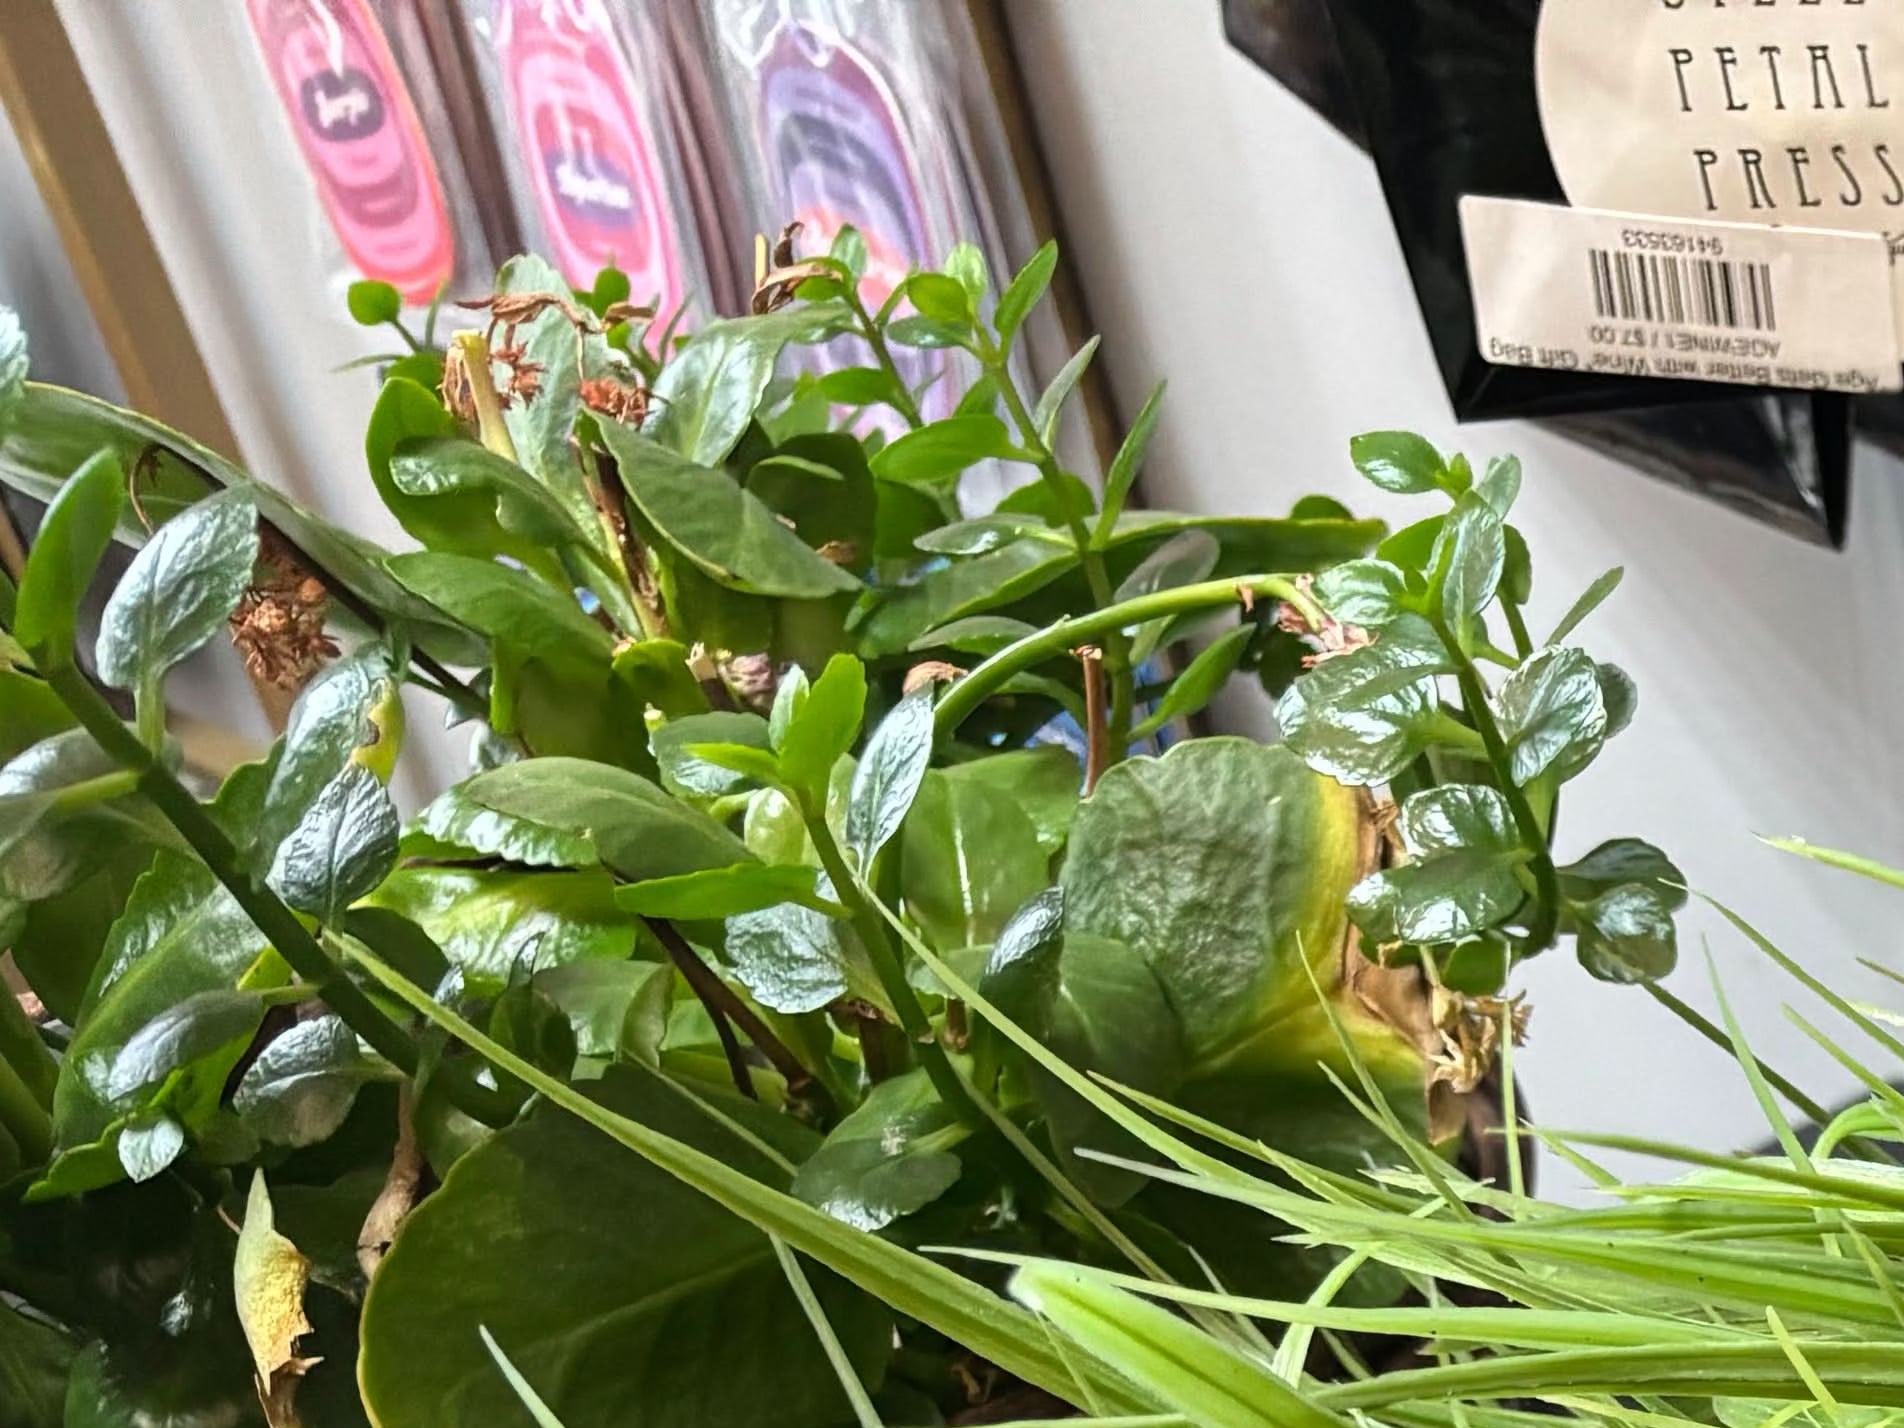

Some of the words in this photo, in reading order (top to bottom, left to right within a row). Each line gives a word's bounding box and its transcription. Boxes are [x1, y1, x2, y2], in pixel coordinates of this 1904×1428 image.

[1668, 43, 1889, 112] PETAL
[1590, 325, 1644, 347] $7.00
[1490, 336, 1533, 366] Bag
[1538, 347, 1578, 370] Gift
[1652, 357, 1697, 378] with
[1706, 361, 1770, 386] Better
